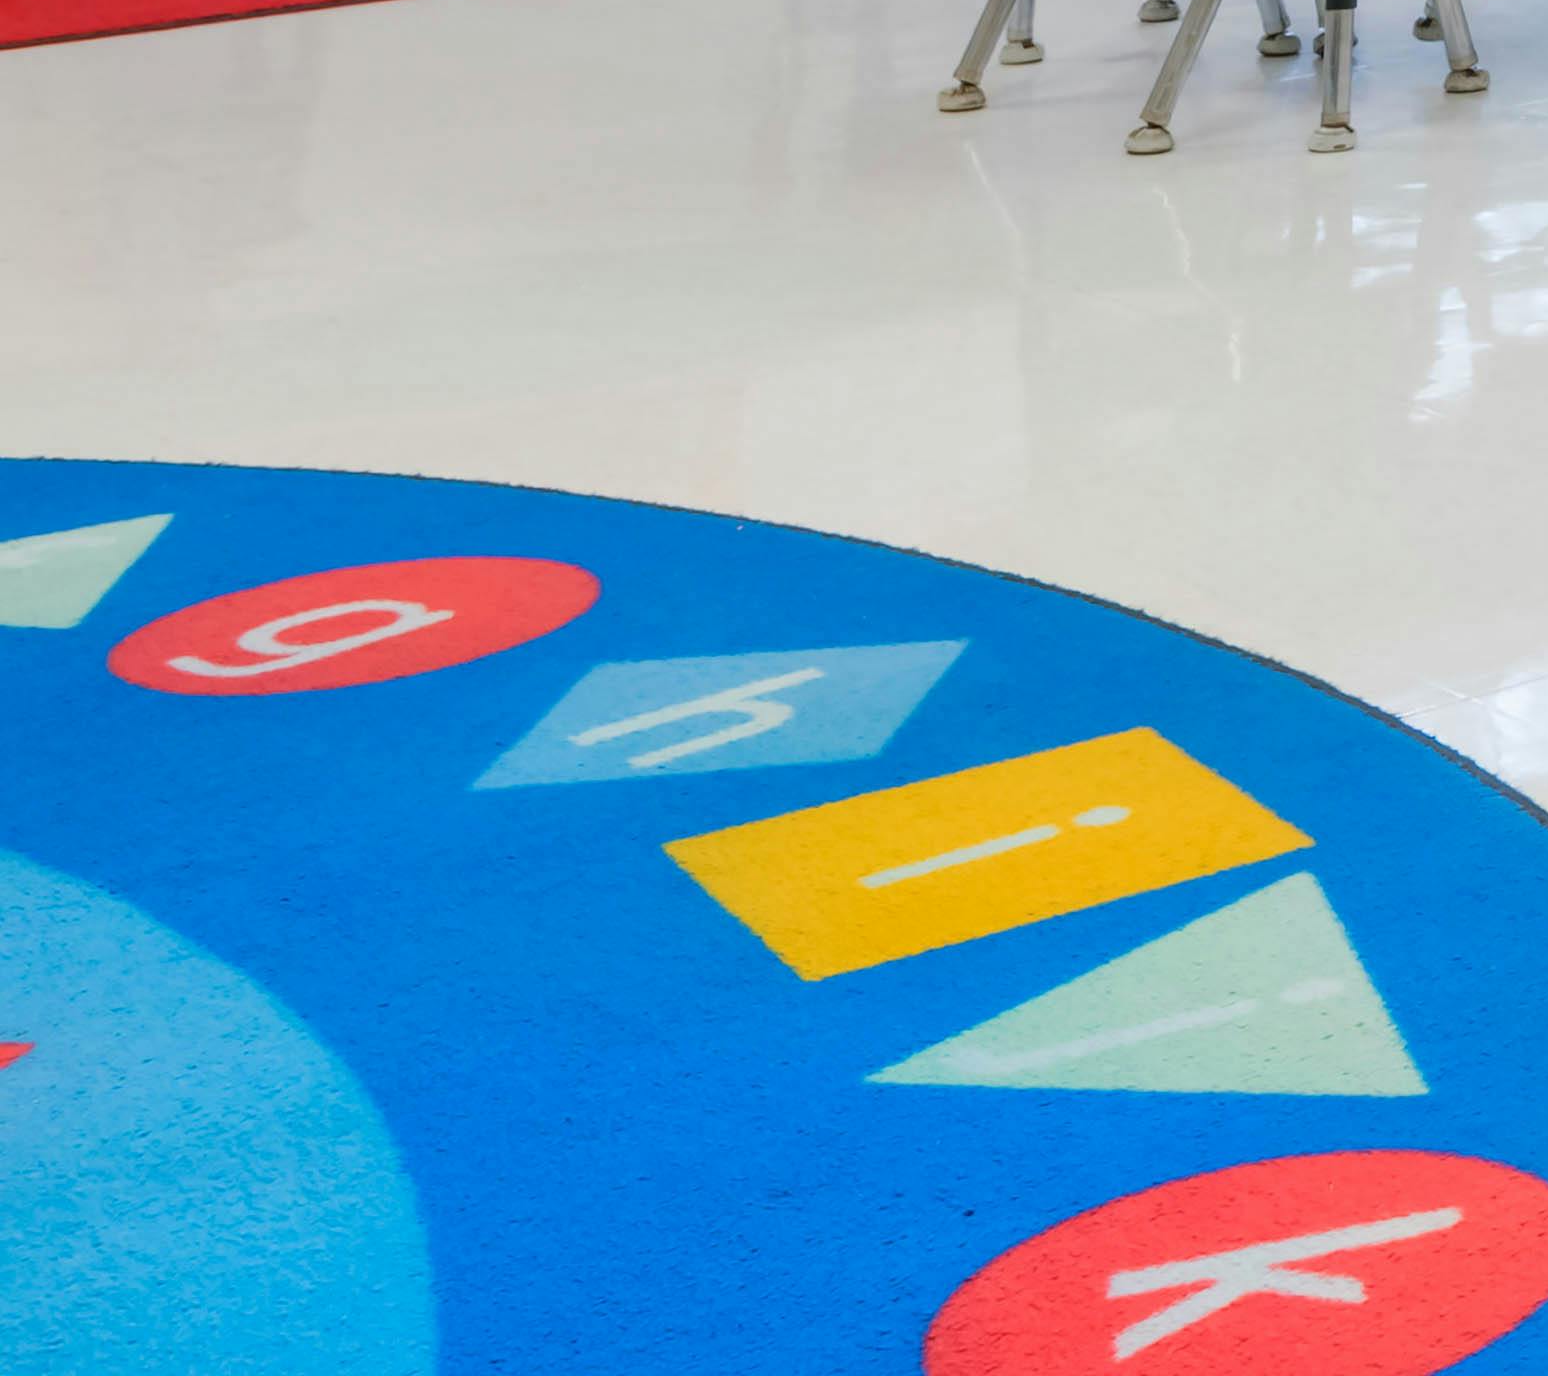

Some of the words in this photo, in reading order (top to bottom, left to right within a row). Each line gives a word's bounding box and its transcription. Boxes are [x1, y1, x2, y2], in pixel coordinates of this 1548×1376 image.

[167, 599, 457, 679] g
[568, 666, 826, 770] h
[858, 803, 1135, 890] i
